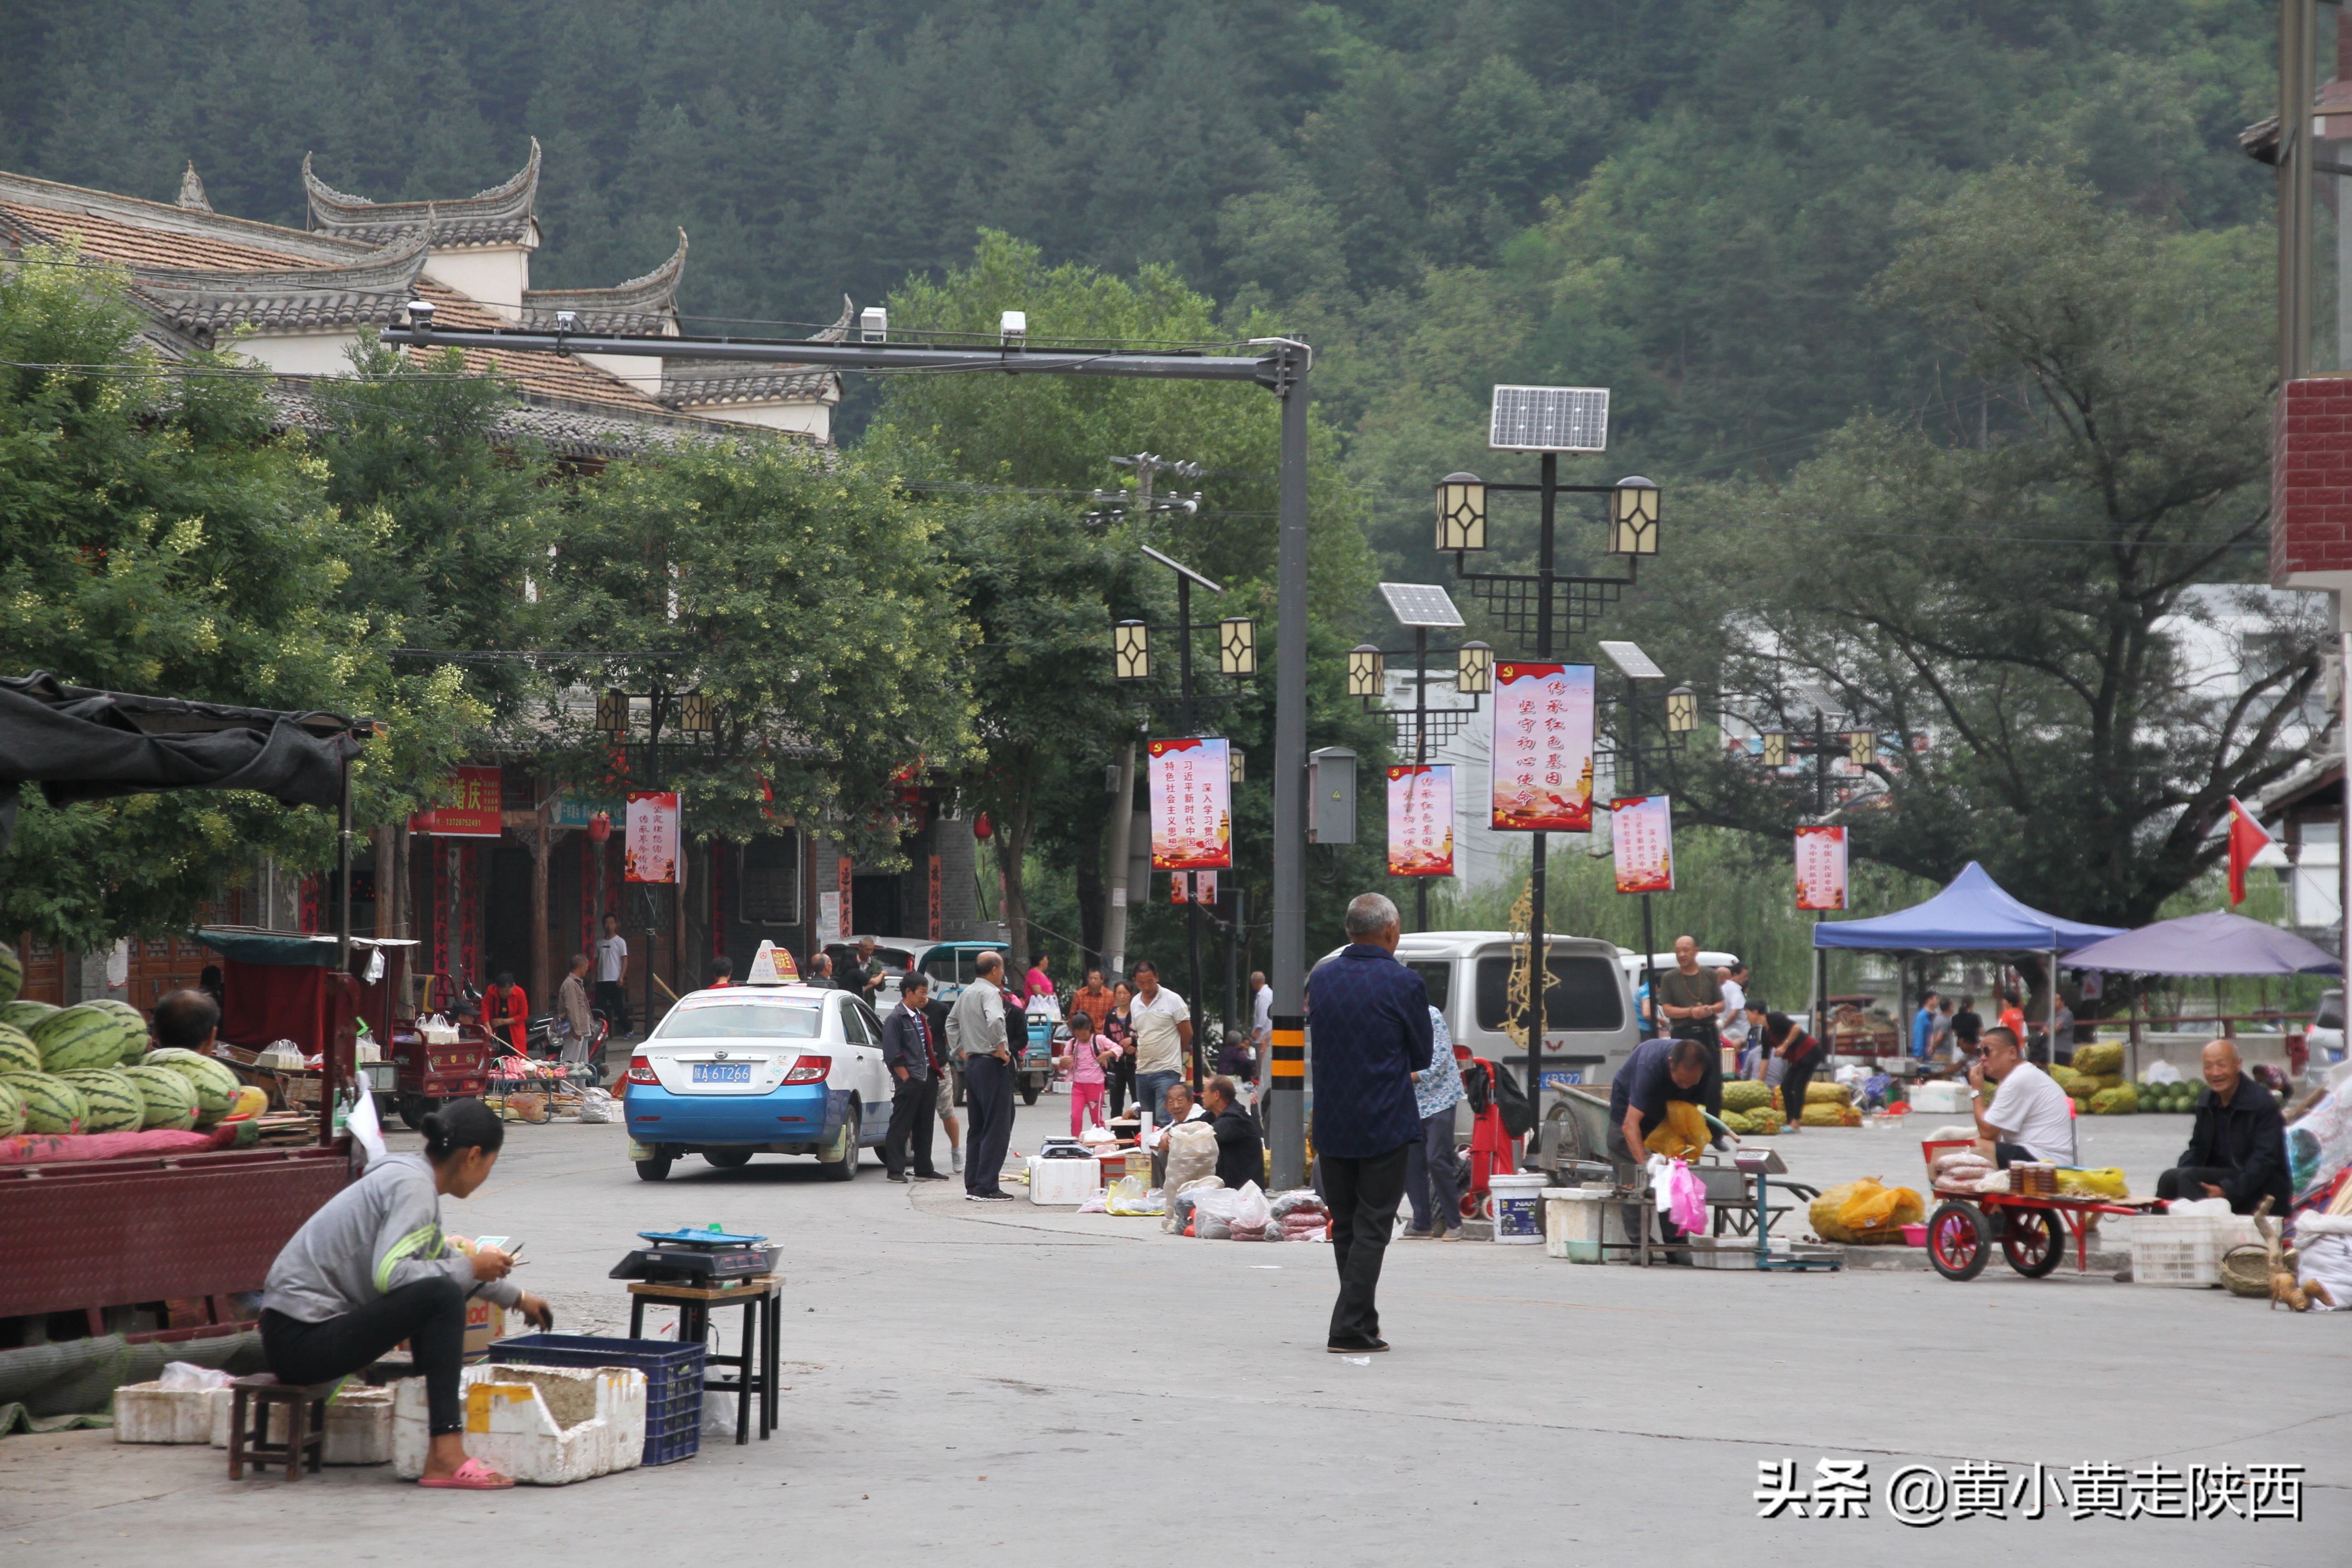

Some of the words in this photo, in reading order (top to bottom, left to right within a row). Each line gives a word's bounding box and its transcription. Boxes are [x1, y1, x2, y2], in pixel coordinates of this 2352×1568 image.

[1517, 700, 1537, 806] 坚守初心使命
[1545, 680, 1567, 785] 传承红色基因
[652, 805, 664, 863] 坚定理想信念
[1165, 761, 1177, 848] 特色社会主义思想
[1184, 760, 1196, 847] 习近平新时代中国
[1202, 783, 1215, 849] 深入学习贯彻
[1420, 776, 1436, 846] 传承红色基因
[638, 815, 650, 873] 传承革命精神
[1622, 814, 1633, 876] 特色社会主义思想
[1637, 813, 1646, 875] 习近平新时代中国
[1649, 829, 1660, 876] 深入学习贯彻
[1809, 843, 1818, 899] 为中华民族谋复兴
[1824, 836, 1833, 892] 为中国人民谋幸福
[694, 1067, 749, 1080] 陕A·6T266
